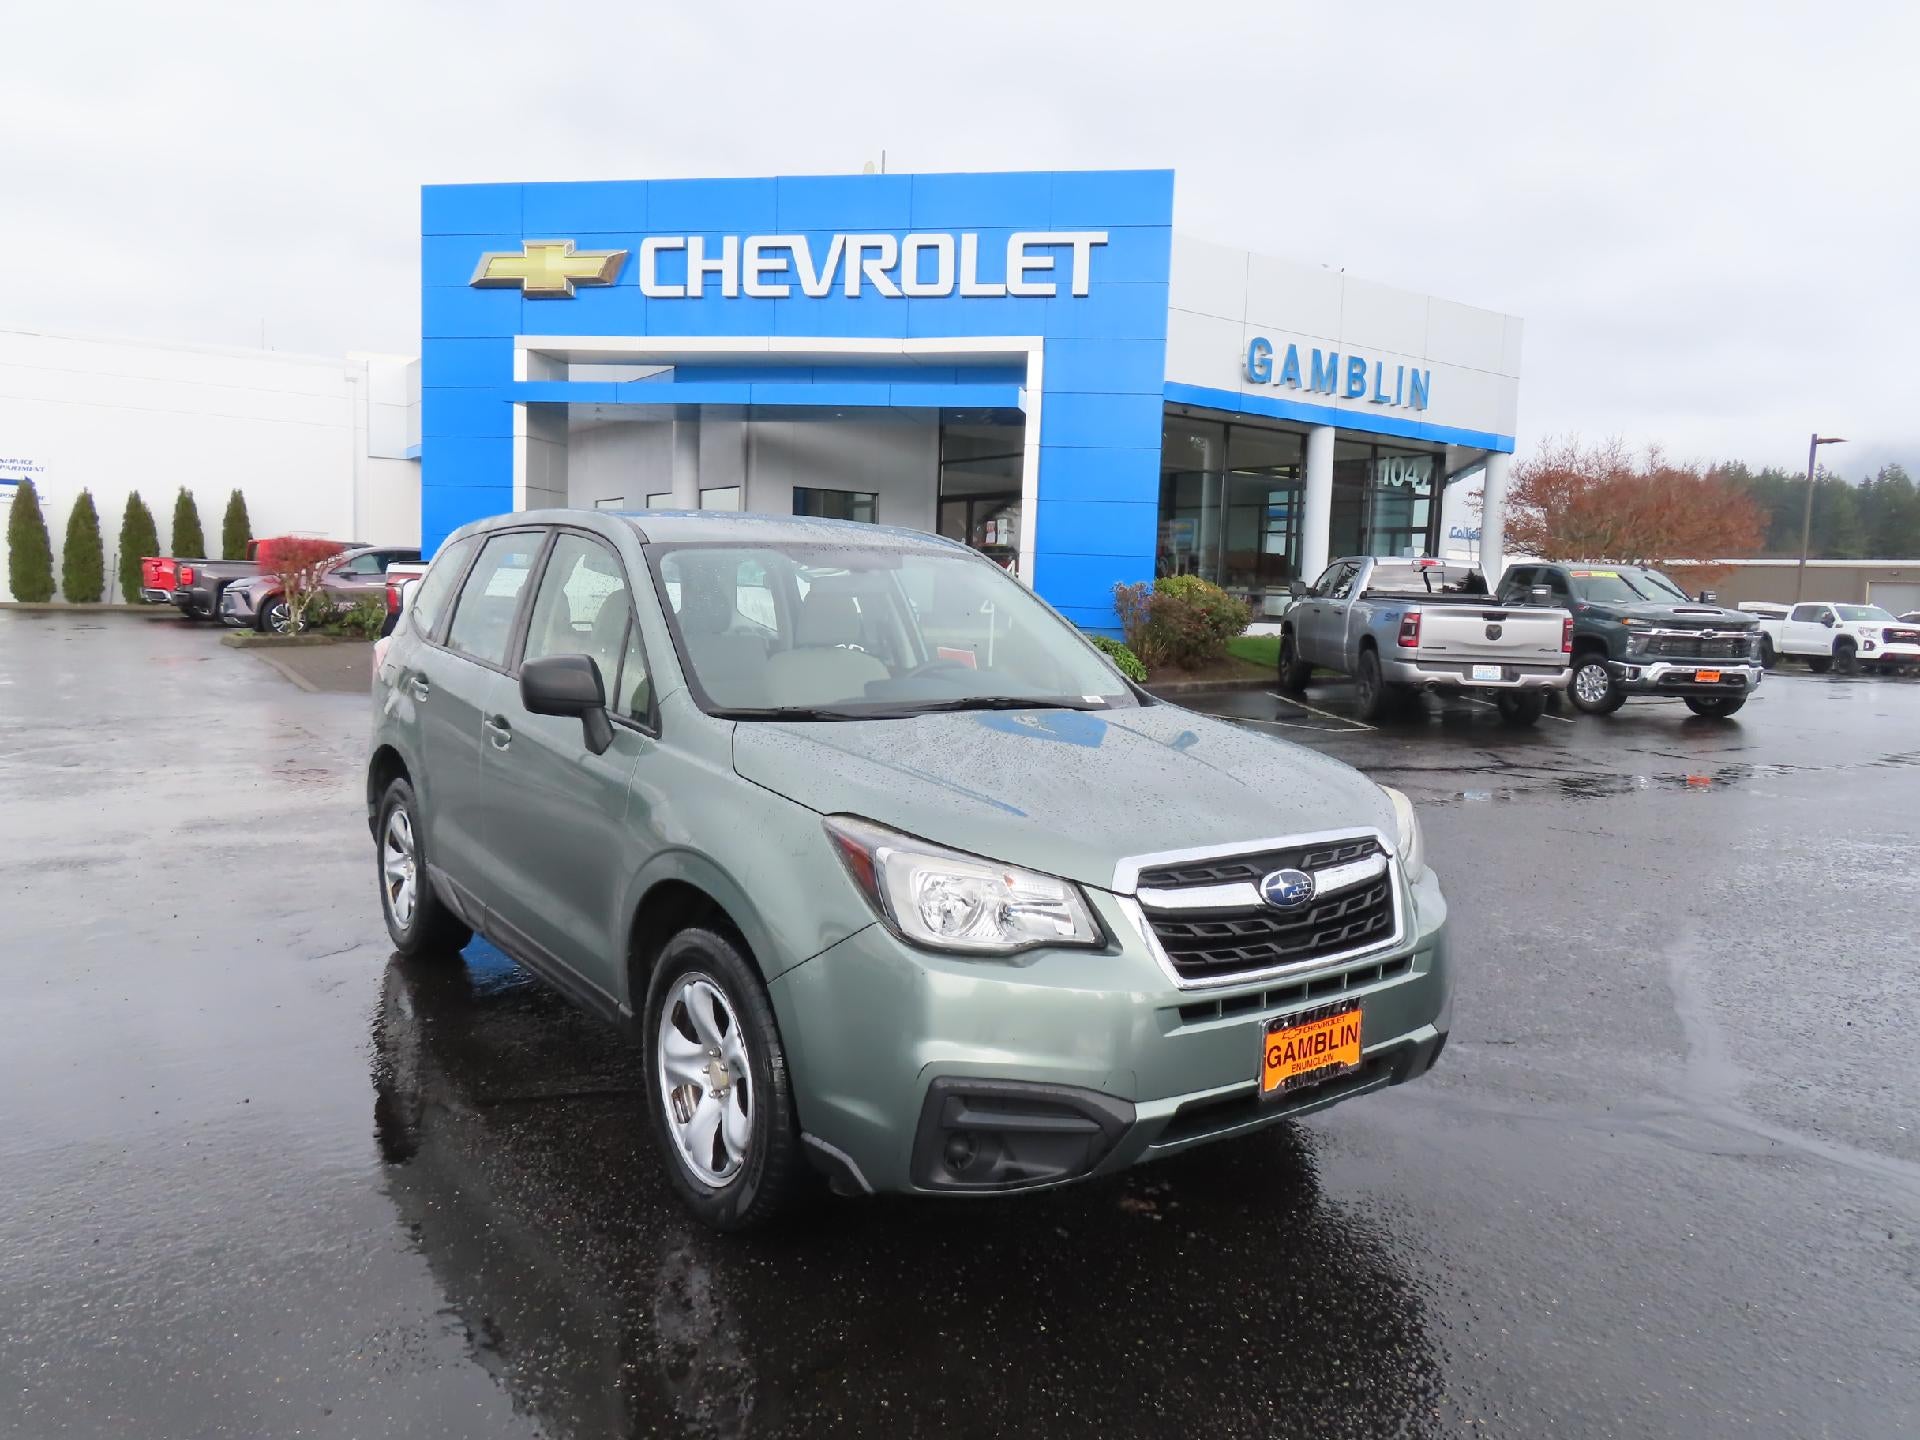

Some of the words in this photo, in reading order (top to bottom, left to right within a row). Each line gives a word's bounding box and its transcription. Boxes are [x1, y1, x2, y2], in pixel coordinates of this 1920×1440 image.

[639, 231, 1108, 299] CHEVROLET
[1246, 336, 1431, 411] GAMBLIN
[1266, 1021, 1359, 1069] GAMBLIN
